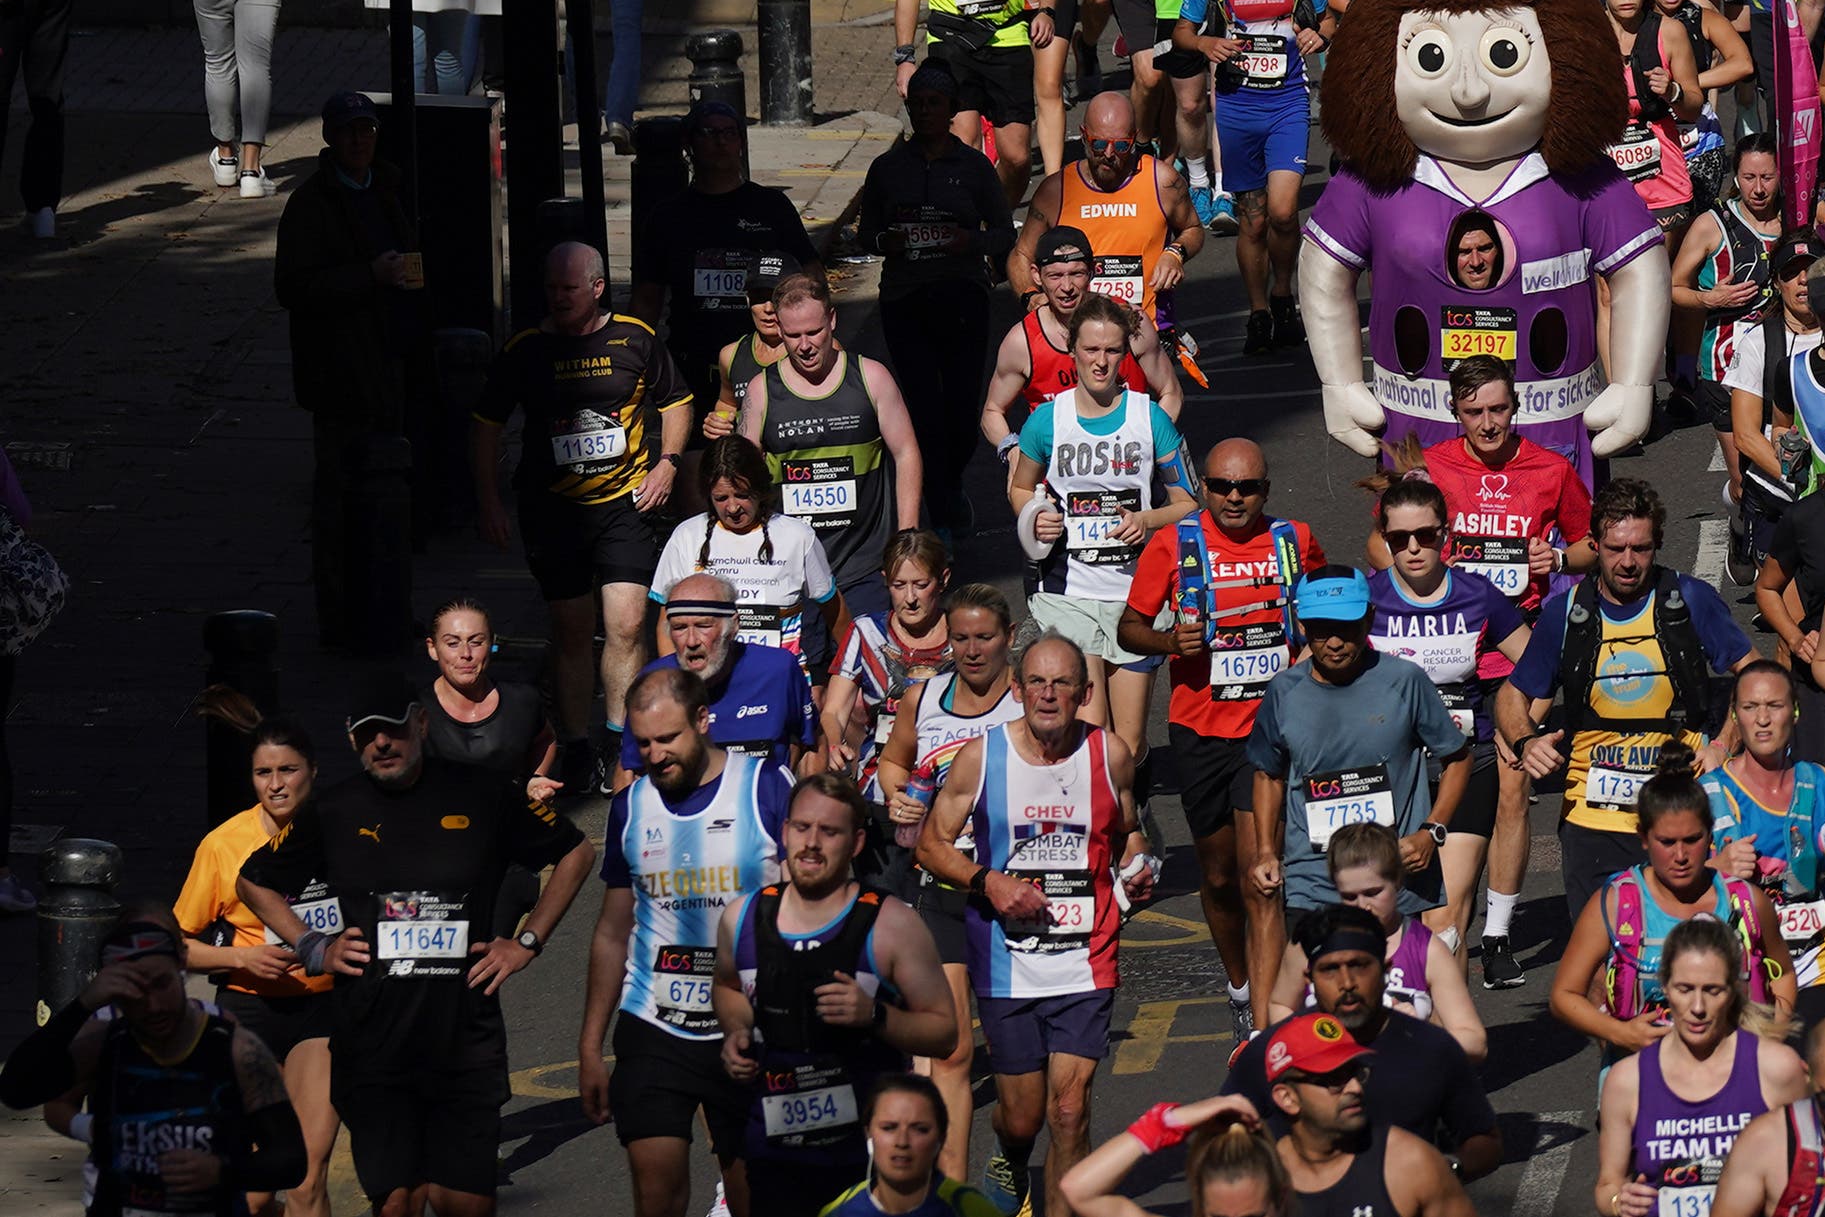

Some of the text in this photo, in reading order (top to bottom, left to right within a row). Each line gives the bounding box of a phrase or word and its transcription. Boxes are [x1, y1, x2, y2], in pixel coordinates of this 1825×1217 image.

[1080, 204, 1136, 218] EDWIN
[1448, 312, 1472, 326] tcs
[1451, 334, 1507, 353] 32197
[554, 357, 611, 372] WITHAM
[554, 367, 613, 380] RUNNING CLUB
[1378, 383, 1583, 412] national for sick
[778, 418, 824, 429] ANTHONY
[778, 424, 825, 438] NOLAN
[561, 434, 617, 459] 11357
[1057, 435, 1143, 478] ROSIE
[787, 465, 811, 482] tcs
[813, 466, 850, 475] CONSULTANCY
[792, 486, 848, 507] 14550
[826, 519, 850, 527] balance
[1452, 513, 1532, 536] ASHLEY
[1456, 542, 1482, 559] tcs
[708, 567, 739, 577] cymru
[1208, 562, 1280, 577] KENYA
[1387, 613, 1467, 638] MARIA
[1215, 633, 1243, 649] tcs
[1246, 629, 1281, 641] CONSULTANCY
[1246, 639, 1271, 647] SERVICES
[1423, 649, 1457, 657] CANCER
[1423, 655, 1471, 665] RESEARCH
[1222, 654, 1281, 678] 16790
[1424, 665, 1437, 673] UK
[747, 705, 768, 714] asics
[1311, 776, 1340, 797] tcs
[1342, 777, 1384, 789] CONSULTANCY
[1344, 784, 1371, 794] SERVICES
[1024, 804, 1075, 818] CHEV
[1325, 801, 1377, 827] 7735
[1019, 835, 1084, 850] COMBAT
[1019, 848, 1078, 862] STRESS
[391, 926, 458, 950] 11647
[661, 951, 691, 972] tcs
[430, 967, 460, 975] balance
[782, 1094, 838, 1125] 3954
[1646, 1136, 1709, 1160] TEAM
